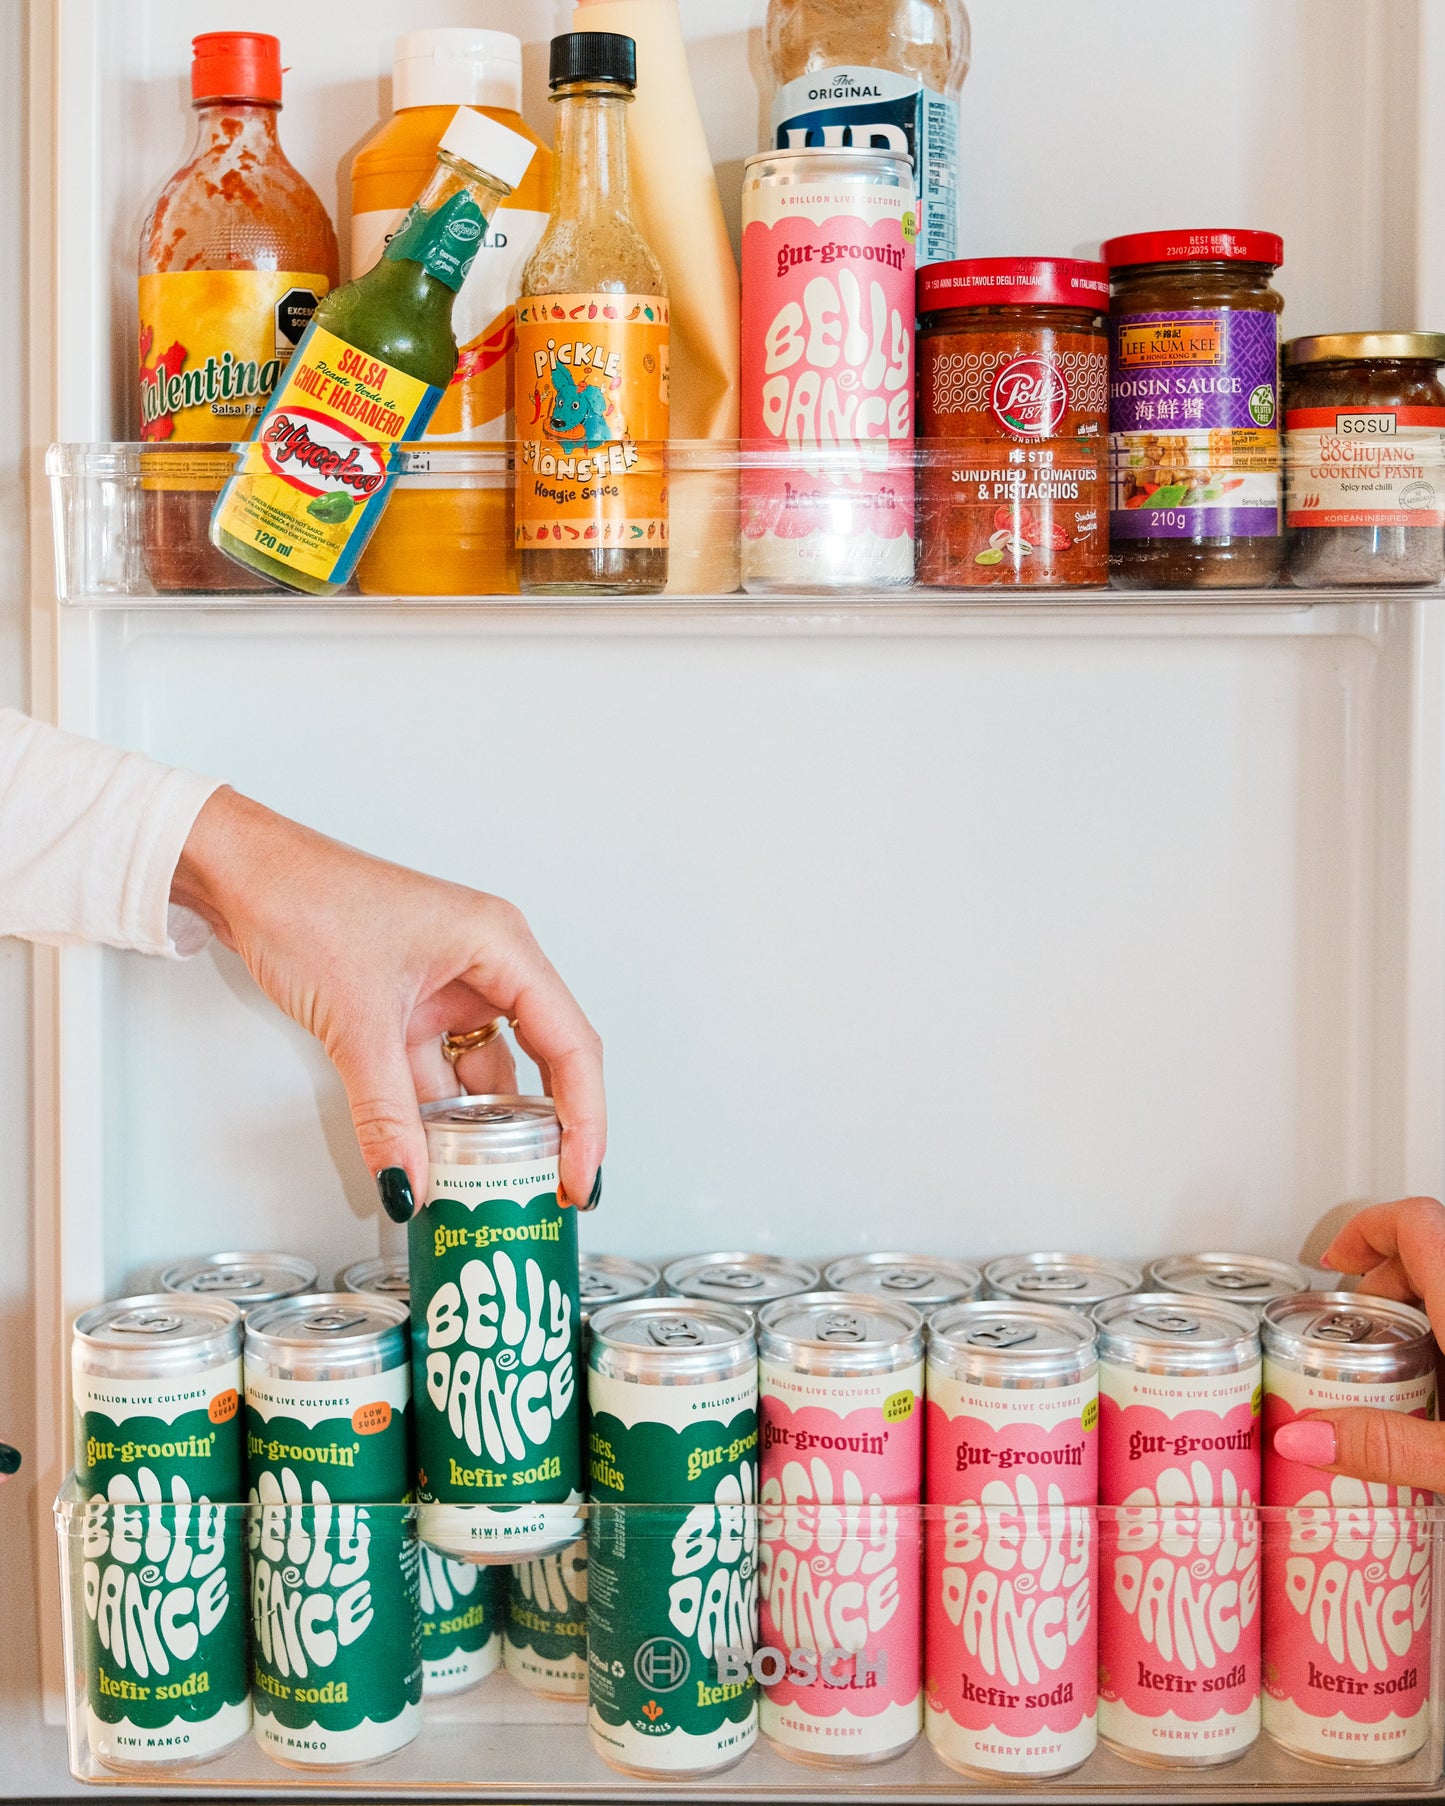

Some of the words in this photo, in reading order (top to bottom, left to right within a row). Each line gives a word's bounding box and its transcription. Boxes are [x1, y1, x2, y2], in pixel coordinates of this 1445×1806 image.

[832, 74, 854, 87] The
[808, 86, 882, 100] ORIGINAL
[789, 195, 830, 205] BILLION
[1190, 236, 1208, 245] BEST
[953, 277, 971, 287] SULLE
[972, 276, 995, 287] TAVOLE
[996, 275, 1015, 286] DEGLI
[1126, 341, 1146, 355] LEE
[1151, 340, 1184, 354] KUM
[1190, 338, 1216, 351] KEE
[533, 338, 621, 378] PICKLE
[1169, 352, 1190, 360] KONG
[337, 348, 389, 391] SALSA
[315, 361, 350, 387] Picante
[354, 382, 382, 404] Verde
[384, 401, 396, 410] de
[1111, 380, 1170, 398] HOISIN
[1175, 377, 1242, 394] SAUCE
[293, 363, 329, 402] CHILE
[327, 391, 406, 439] HABANERO
[211, 404, 241, 413] Salsa
[1254, 405, 1272, 414] GLUTEN
[1257, 413, 1269, 423] FREE
[1343, 419, 1390, 433] SOSU
[1008, 450, 1054, 463] PESTO
[1320, 447, 1415, 464] GOCHUJANG
[951, 469, 1027, 482] SUNDRIED
[1031, 469, 1097, 482] TOMATOES
[1310, 466, 1380, 479] COOKING
[1385, 466, 1424, 479] PASTE
[535, 480, 577, 504] Hoagie
[581, 484, 620, 500] Sauce
[978, 484, 990, 500] &
[993, 483, 1079, 500] PISTACHIOS
[1340, 483, 1360, 493] Spicy
[1361, 483, 1373, 491] red
[1374, 483, 1393, 491] chilli
[1324, 514, 1363, 523] KOREAN
[1364, 514, 1409, 523] INSPIRED
[254, 529, 277, 549] 120
[276, 541, 293, 557] ml
[444, 1179, 481, 1188] BILLION
[486, 1179, 508, 1188] LIVE
[512, 1172, 556, 1187] CULTURES
[434, 1216, 563, 1257] gut-groovin'
[771, 1378, 803, 1393] BILLION
[806, 1386, 828, 1397] LIVE
[831, 1386, 882, 1397] CULTURES
[1142, 1386, 1182, 1398] BILLION
[1187, 1390, 1208, 1398] LIVE
[1212, 1383, 1250, 1397] CULTURES
[93, 1392, 127, 1404] BILLION
[131, 1396, 153, 1405] LIVE
[157, 1388, 207, 1403] CULTURES
[217, 1395, 232, 1407] LOW
[276, 1397, 296, 1406] LIVE
[299, 1398, 350, 1407] CULTURES
[892, 1396, 909, 1408] LOW
[1309, 1388, 1314, 1396] 6
[1317, 1390, 1360, 1402] BILLION
[1364, 1395, 1386, 1403] LIVE
[1389, 1387, 1427, 1402] CULTURES
[213, 1402, 236, 1418] SUGAR
[691, 1402, 697, 1410] 6
[701, 1396, 735, 1409] BILLION
[968, 1398, 1008, 1410] BILLION
[1012, 1403, 1035, 1411] LIVE
[1038, 1397, 1081, 1411] CULTURES
[363, 1408, 382, 1419] LOW
[887, 1405, 912, 1418] SUGAR
[358, 1416, 388, 1429] SUGAR
[956, 1440, 1086, 1472] gut-groovin'
[449, 1457, 508, 1487] kefir
[512, 1455, 562, 1486] soda
[471, 1527, 498, 1536] KIWI
[504, 1522, 545, 1536] MANGO
[440, 1604, 484, 1635] soda
[717, 1645, 888, 1686] BOSCH
[99, 1666, 151, 1701] kefir
[155, 1671, 210, 1701] soda
[1137, 1661, 1197, 1693] kefir
[1202, 1664, 1246, 1693] soda
[1307, 1661, 1368, 1695] kefir
[1373, 1667, 1418, 1696] soda
[295, 1680, 349, 1704] soda
[962, 1673, 1020, 1709] kefir
[1025, 1682, 1074, 1709] soda
[648, 1722, 671, 1733] CALS
[780, 1716, 821, 1736] CHERRY
[825, 1727, 864, 1737] BERRY
[1152, 1728, 1199, 1740] CHERRY
[1204, 1726, 1237, 1740] BERRY
[117, 1735, 141, 1747] KIWI
[147, 1734, 190, 1747] MANGO
[265, 1730, 283, 1743] KIWI
[287, 1737, 327, 1750] MANGO
[717, 1735, 738, 1749] KIWI
[1321, 1728, 1368, 1741] CHERRY
[1374, 1728, 1407, 1742] BERRY
[974, 1741, 1020, 1756] CHERRY
[1026, 1743, 1062, 1756] BERRY
